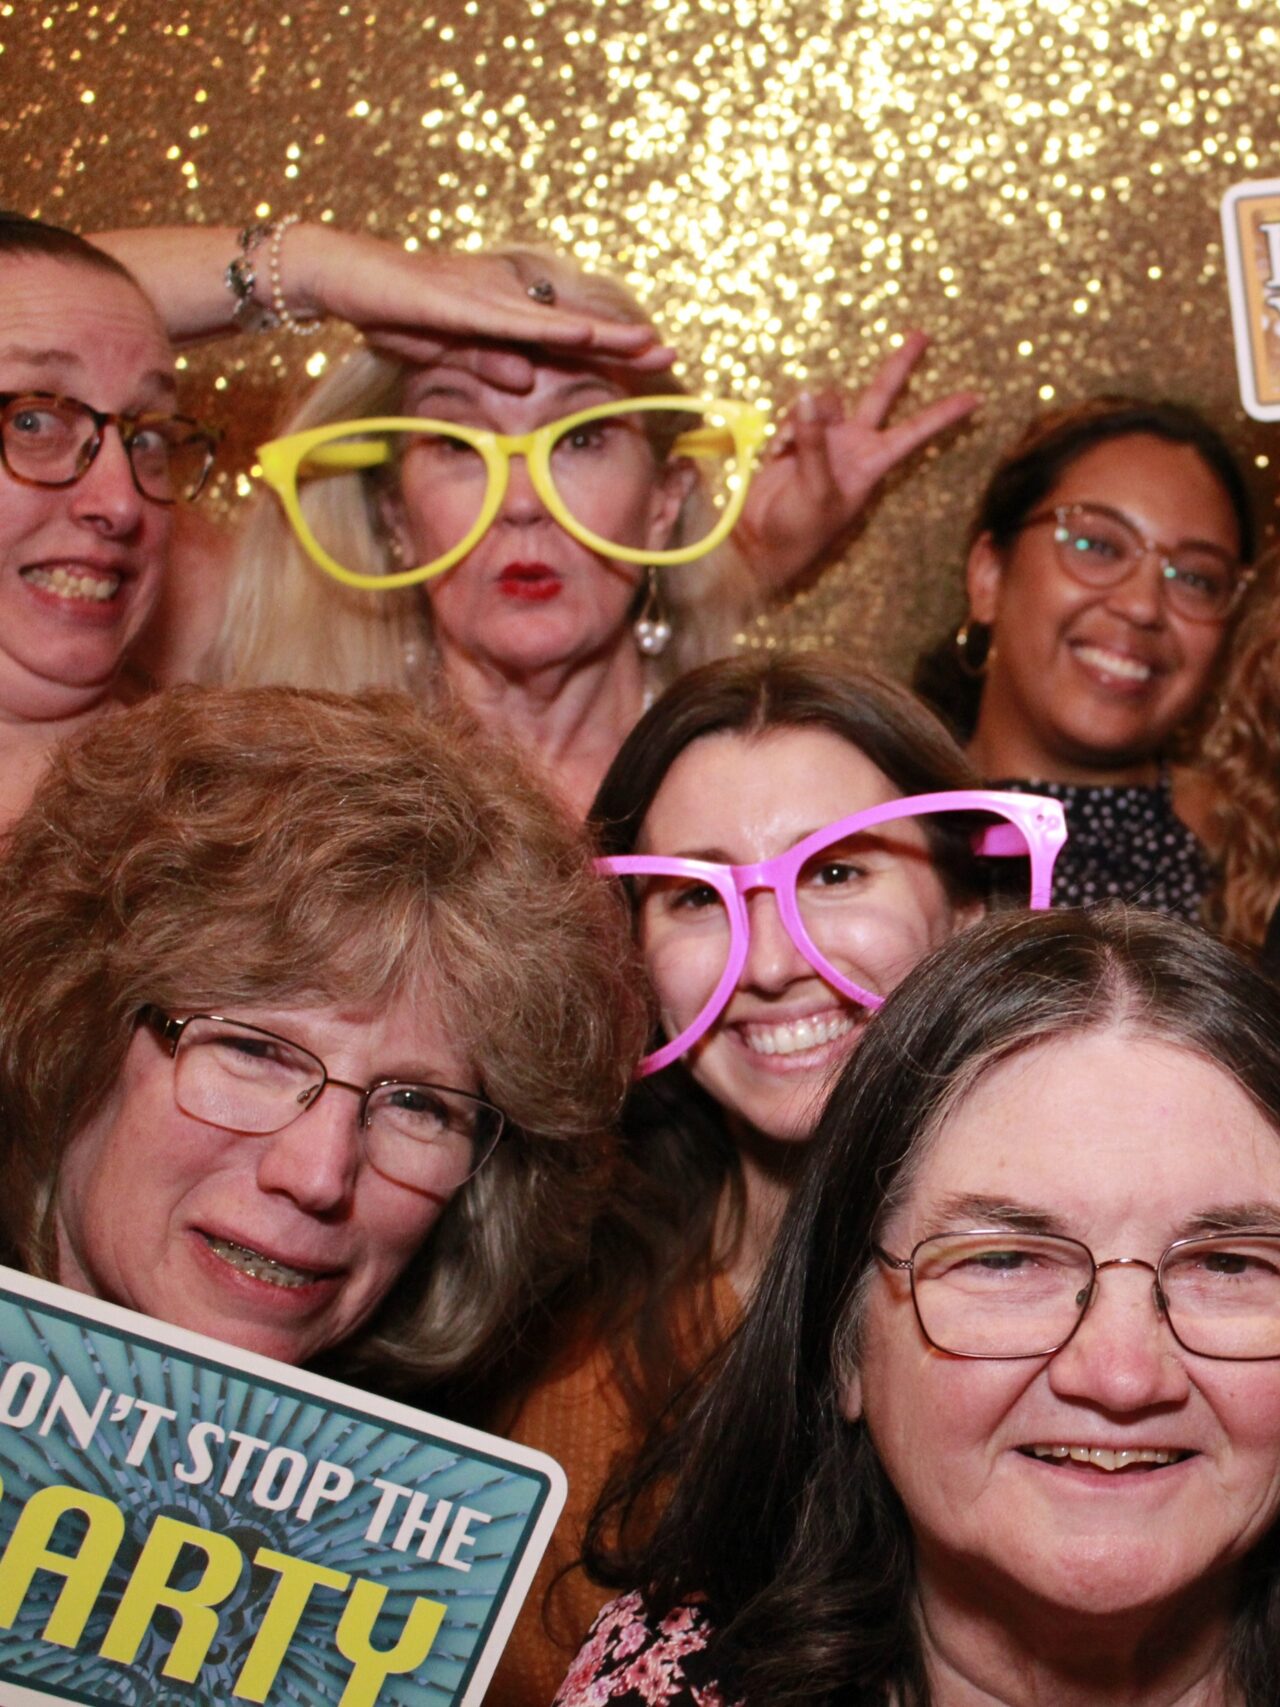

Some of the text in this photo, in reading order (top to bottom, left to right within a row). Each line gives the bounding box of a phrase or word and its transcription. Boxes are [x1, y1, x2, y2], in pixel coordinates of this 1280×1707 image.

[0, 1361, 491, 1572] ON'T STOP THE
[0, 1473, 448, 1707] ARTY
